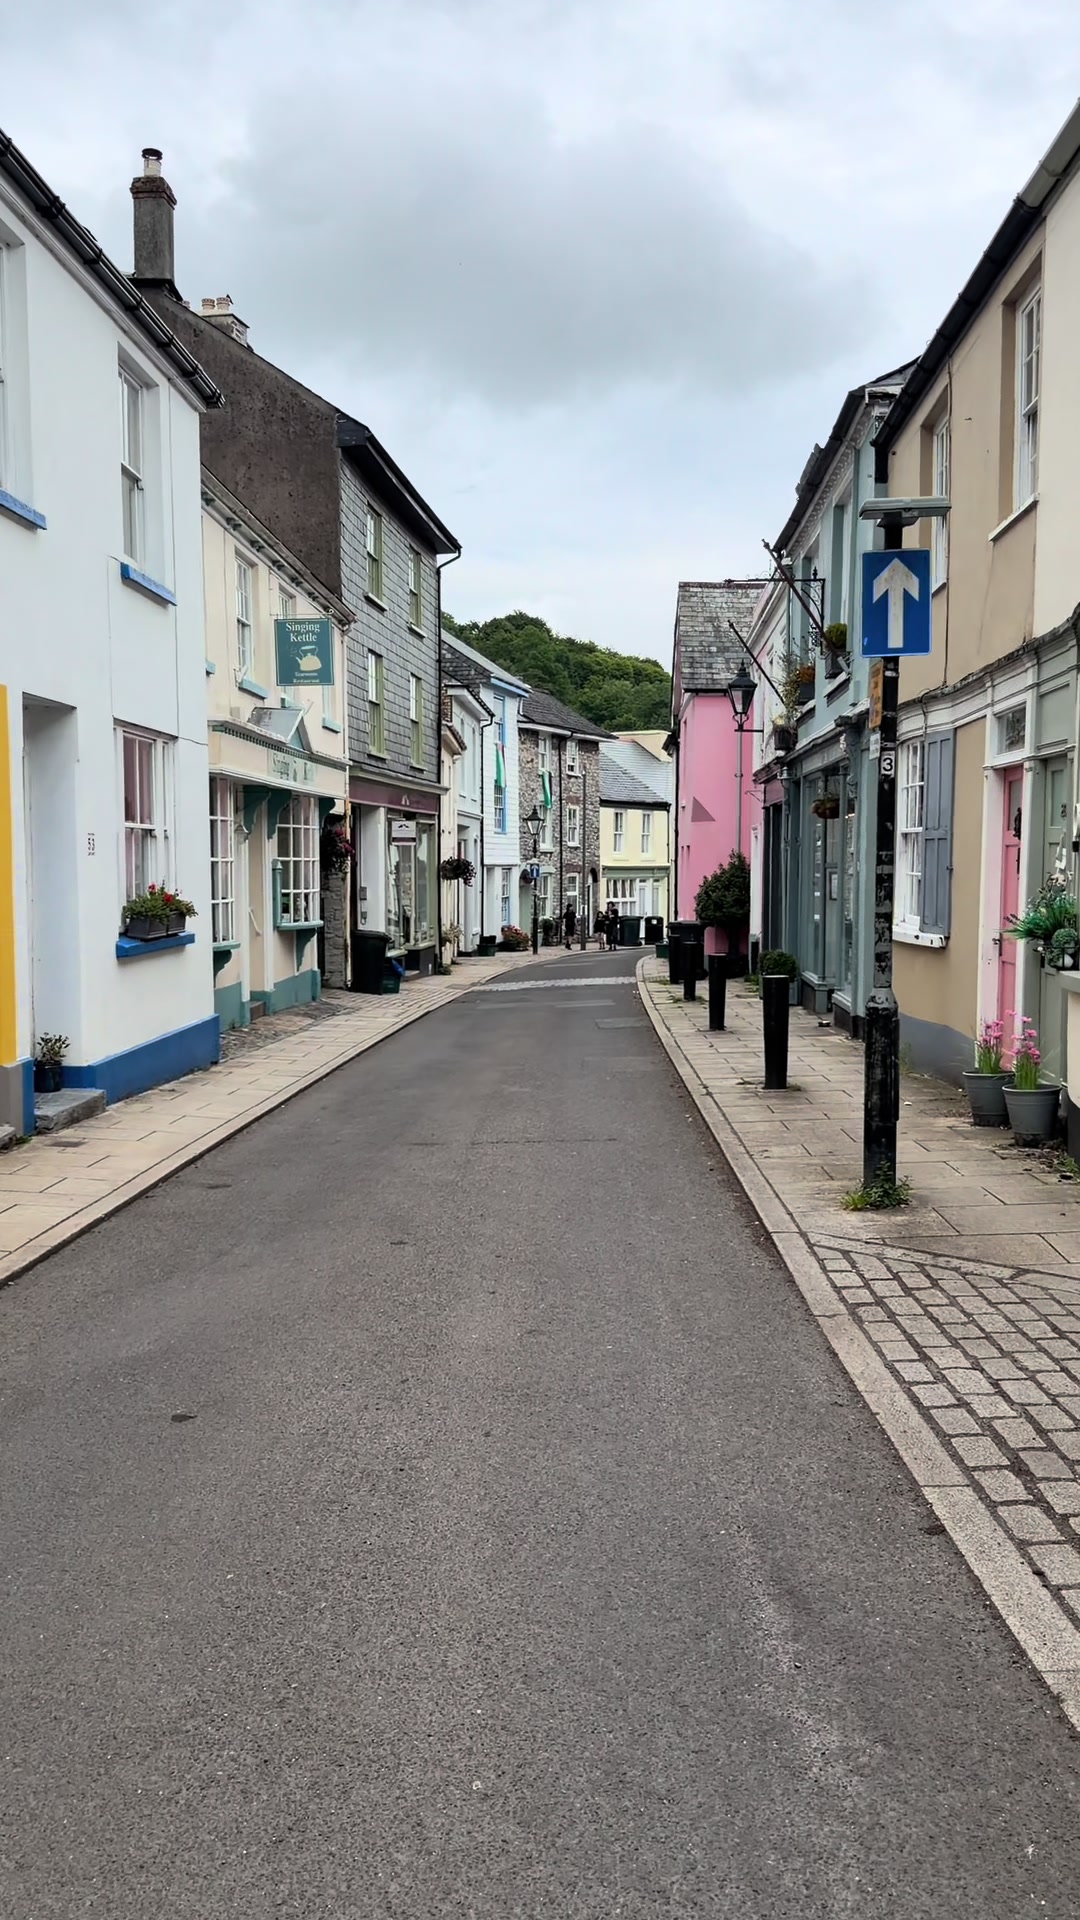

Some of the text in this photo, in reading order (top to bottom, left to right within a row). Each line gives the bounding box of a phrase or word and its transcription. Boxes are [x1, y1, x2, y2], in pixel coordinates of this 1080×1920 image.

[286, 622, 320, 633] Singing
[290, 633, 317, 641] Kettle
[882, 757, 893, 772] 3
